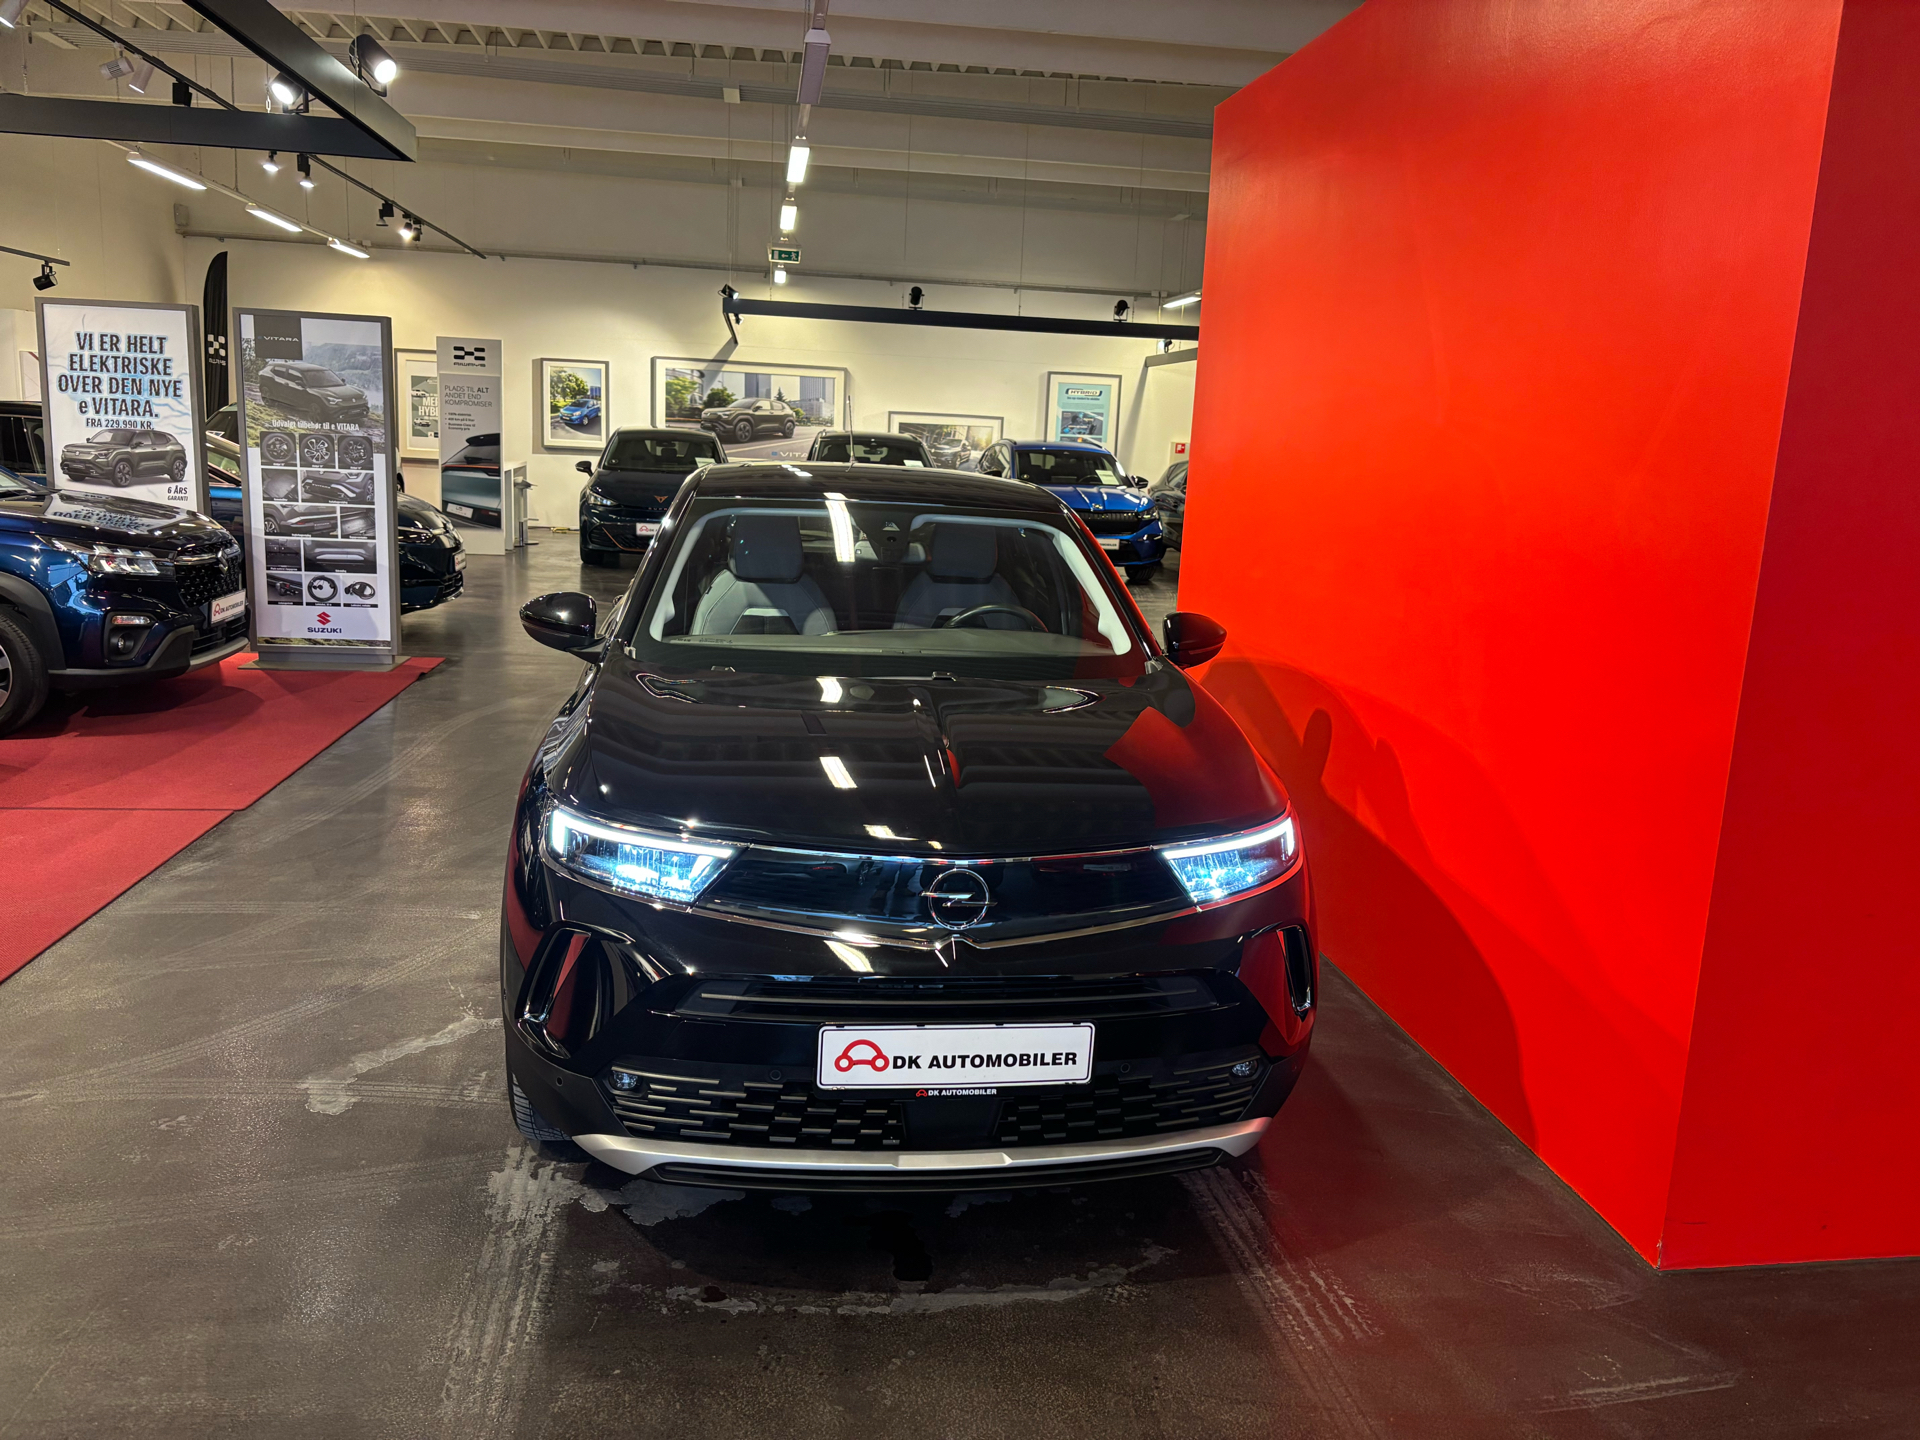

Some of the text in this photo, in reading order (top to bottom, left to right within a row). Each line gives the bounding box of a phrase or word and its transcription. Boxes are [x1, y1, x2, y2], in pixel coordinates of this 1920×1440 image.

[76, 332, 167, 355] VI ER HELT
[69, 353, 172, 376] ELEKTRISKE
[58, 374, 182, 398] OVER DEN NYE
[444, 384, 465, 393] PLADS
[79, 397, 159, 418] e VITARA.
[444, 399, 492, 408] KOMPROMISER
[86, 417, 102, 428] FRA
[104, 419, 138, 429] 229.990
[271, 419, 297, 429] Udvalgt
[297, 420, 321, 430] tilbehør
[336, 422, 359, 431] VITARA
[167, 484, 188, 495] 6 ÅRS
[892, 1052, 1077, 1070] DK AUTOMOBILER
[941, 1088, 997, 1096] AUTOMOBILER
